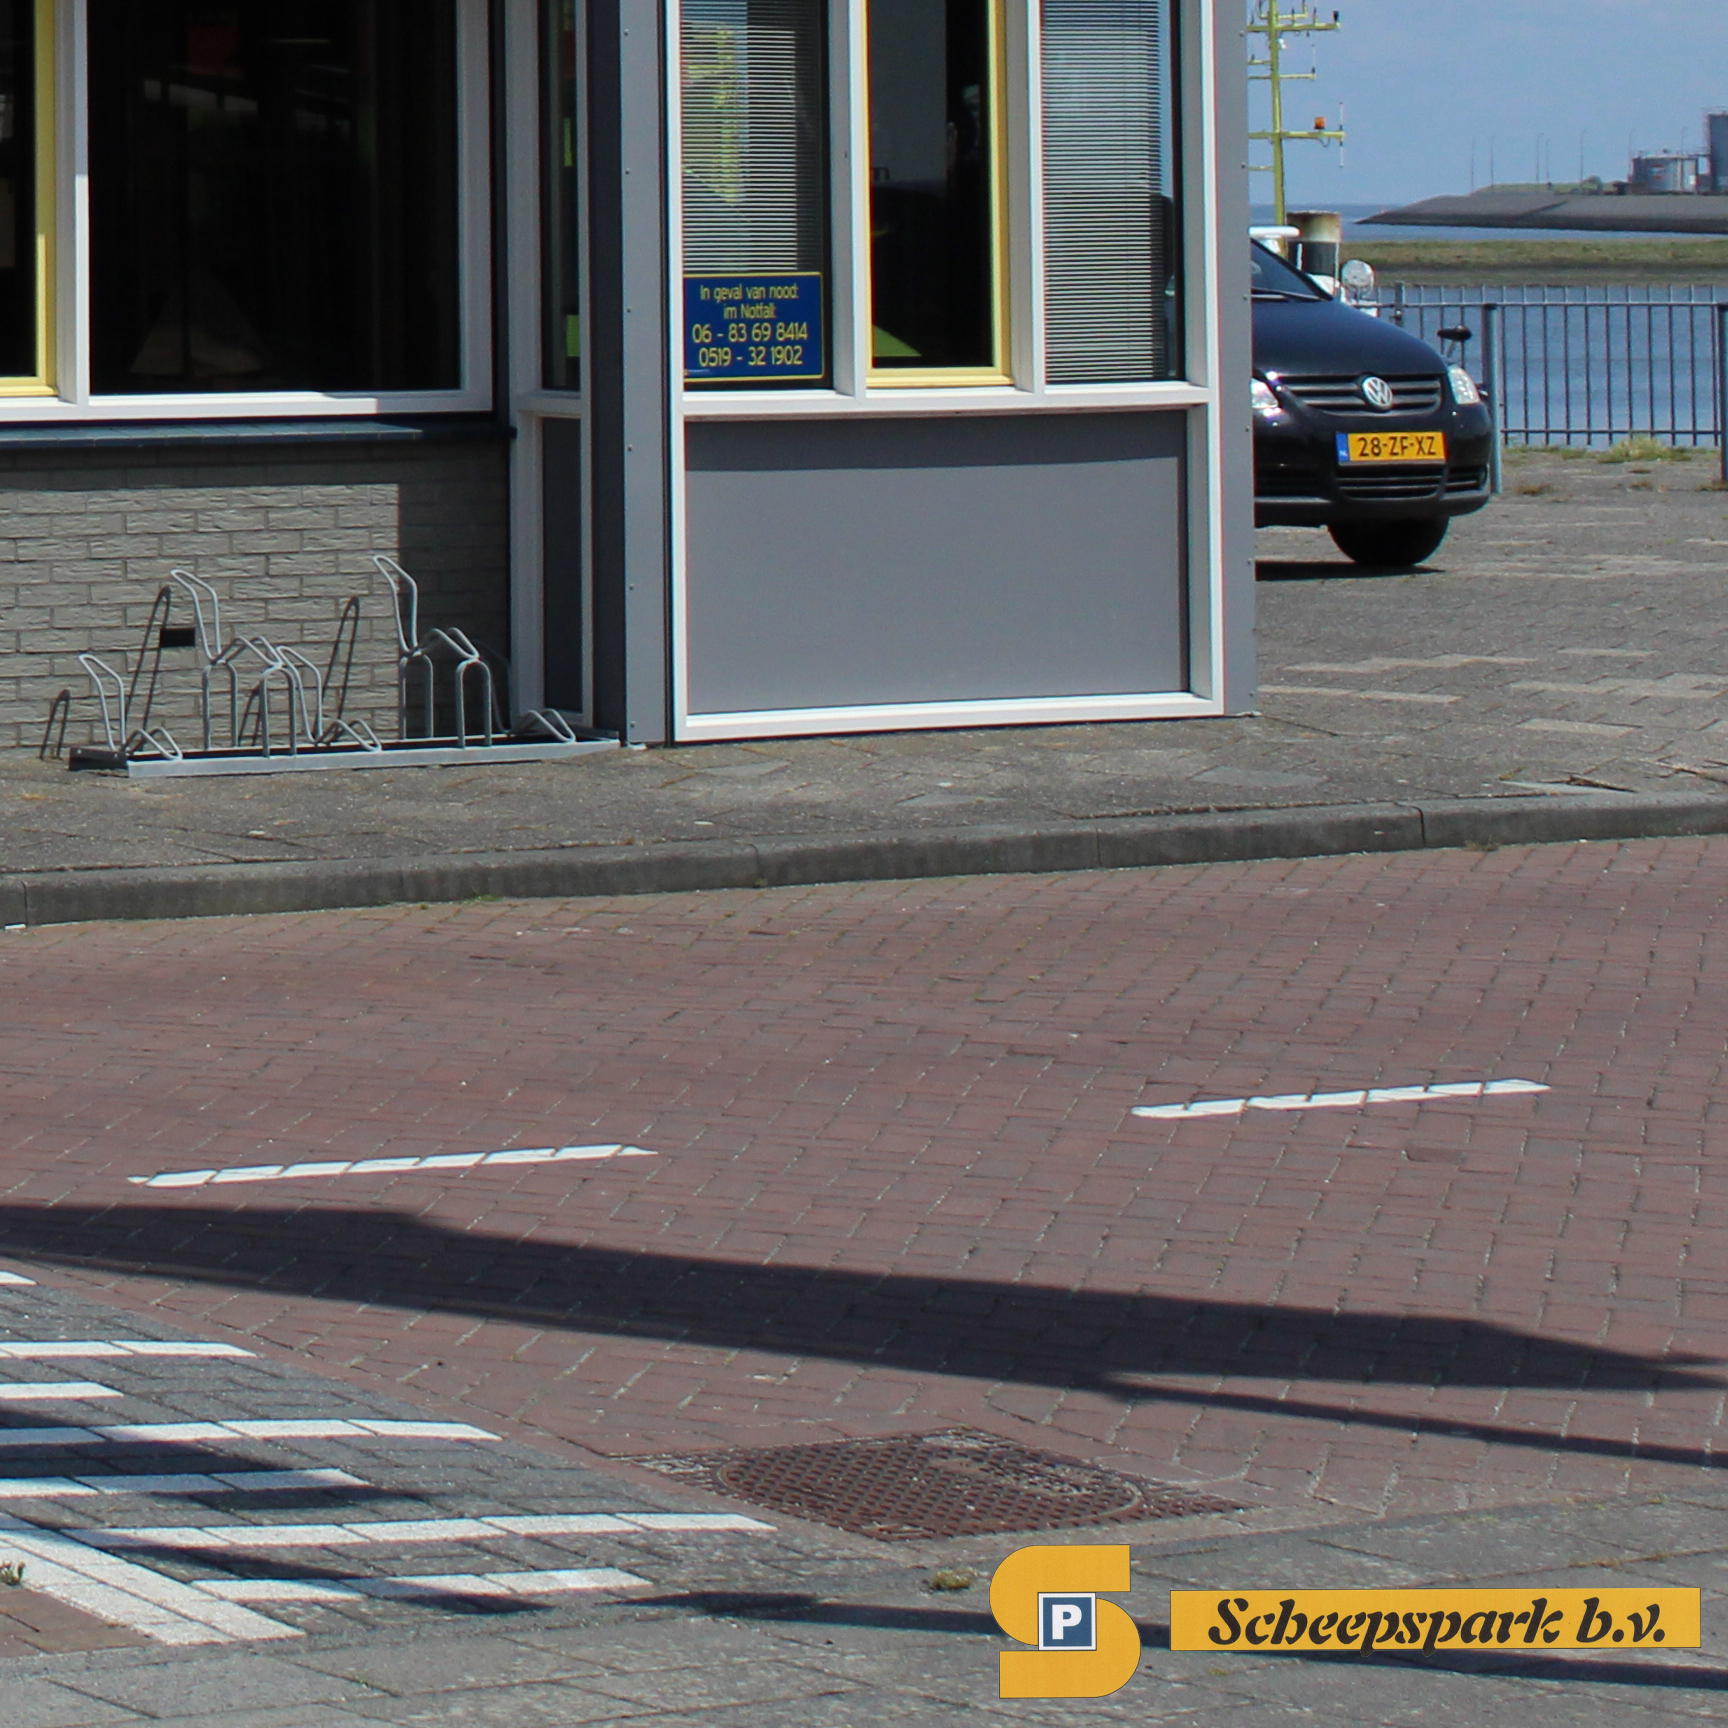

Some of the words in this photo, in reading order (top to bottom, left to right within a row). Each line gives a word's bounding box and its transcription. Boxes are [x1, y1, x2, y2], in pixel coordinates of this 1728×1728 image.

[700, 284, 710, 300] In
[713, 283, 743, 303] geval
[746, 286, 766, 299] van
[723, 304, 737, 319] im
[692, 323, 712, 343] 06
[728, 323, 747, 342] 83
[751, 322, 772, 342] 69
[775, 321, 808, 341] 8414
[699, 347, 732, 367] 0519
[747, 346, 766, 366] 32
[770, 345, 803, 365] 1902
[1357, 436, 1437, 457] 28-ZF-XZ
